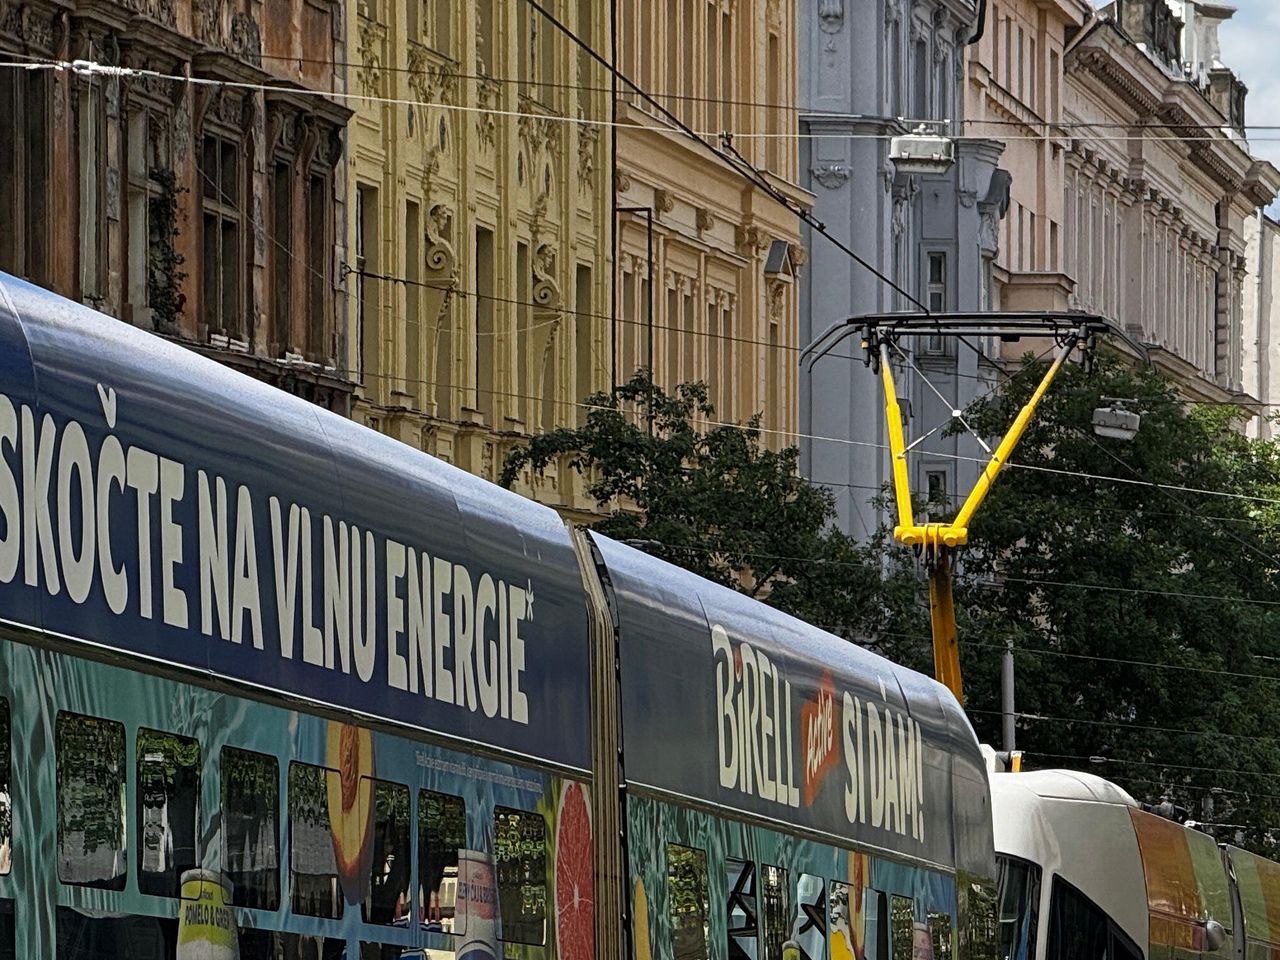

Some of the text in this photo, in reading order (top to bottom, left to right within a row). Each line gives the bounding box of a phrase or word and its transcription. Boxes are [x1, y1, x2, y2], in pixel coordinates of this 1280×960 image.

[0, 383, 188, 630] SKOČTE
[198, 470, 264, 650] NA
[269, 496, 376, 683] VLNU
[842, 690, 866, 825] SI
[866, 674, 925, 844] DÁM!
